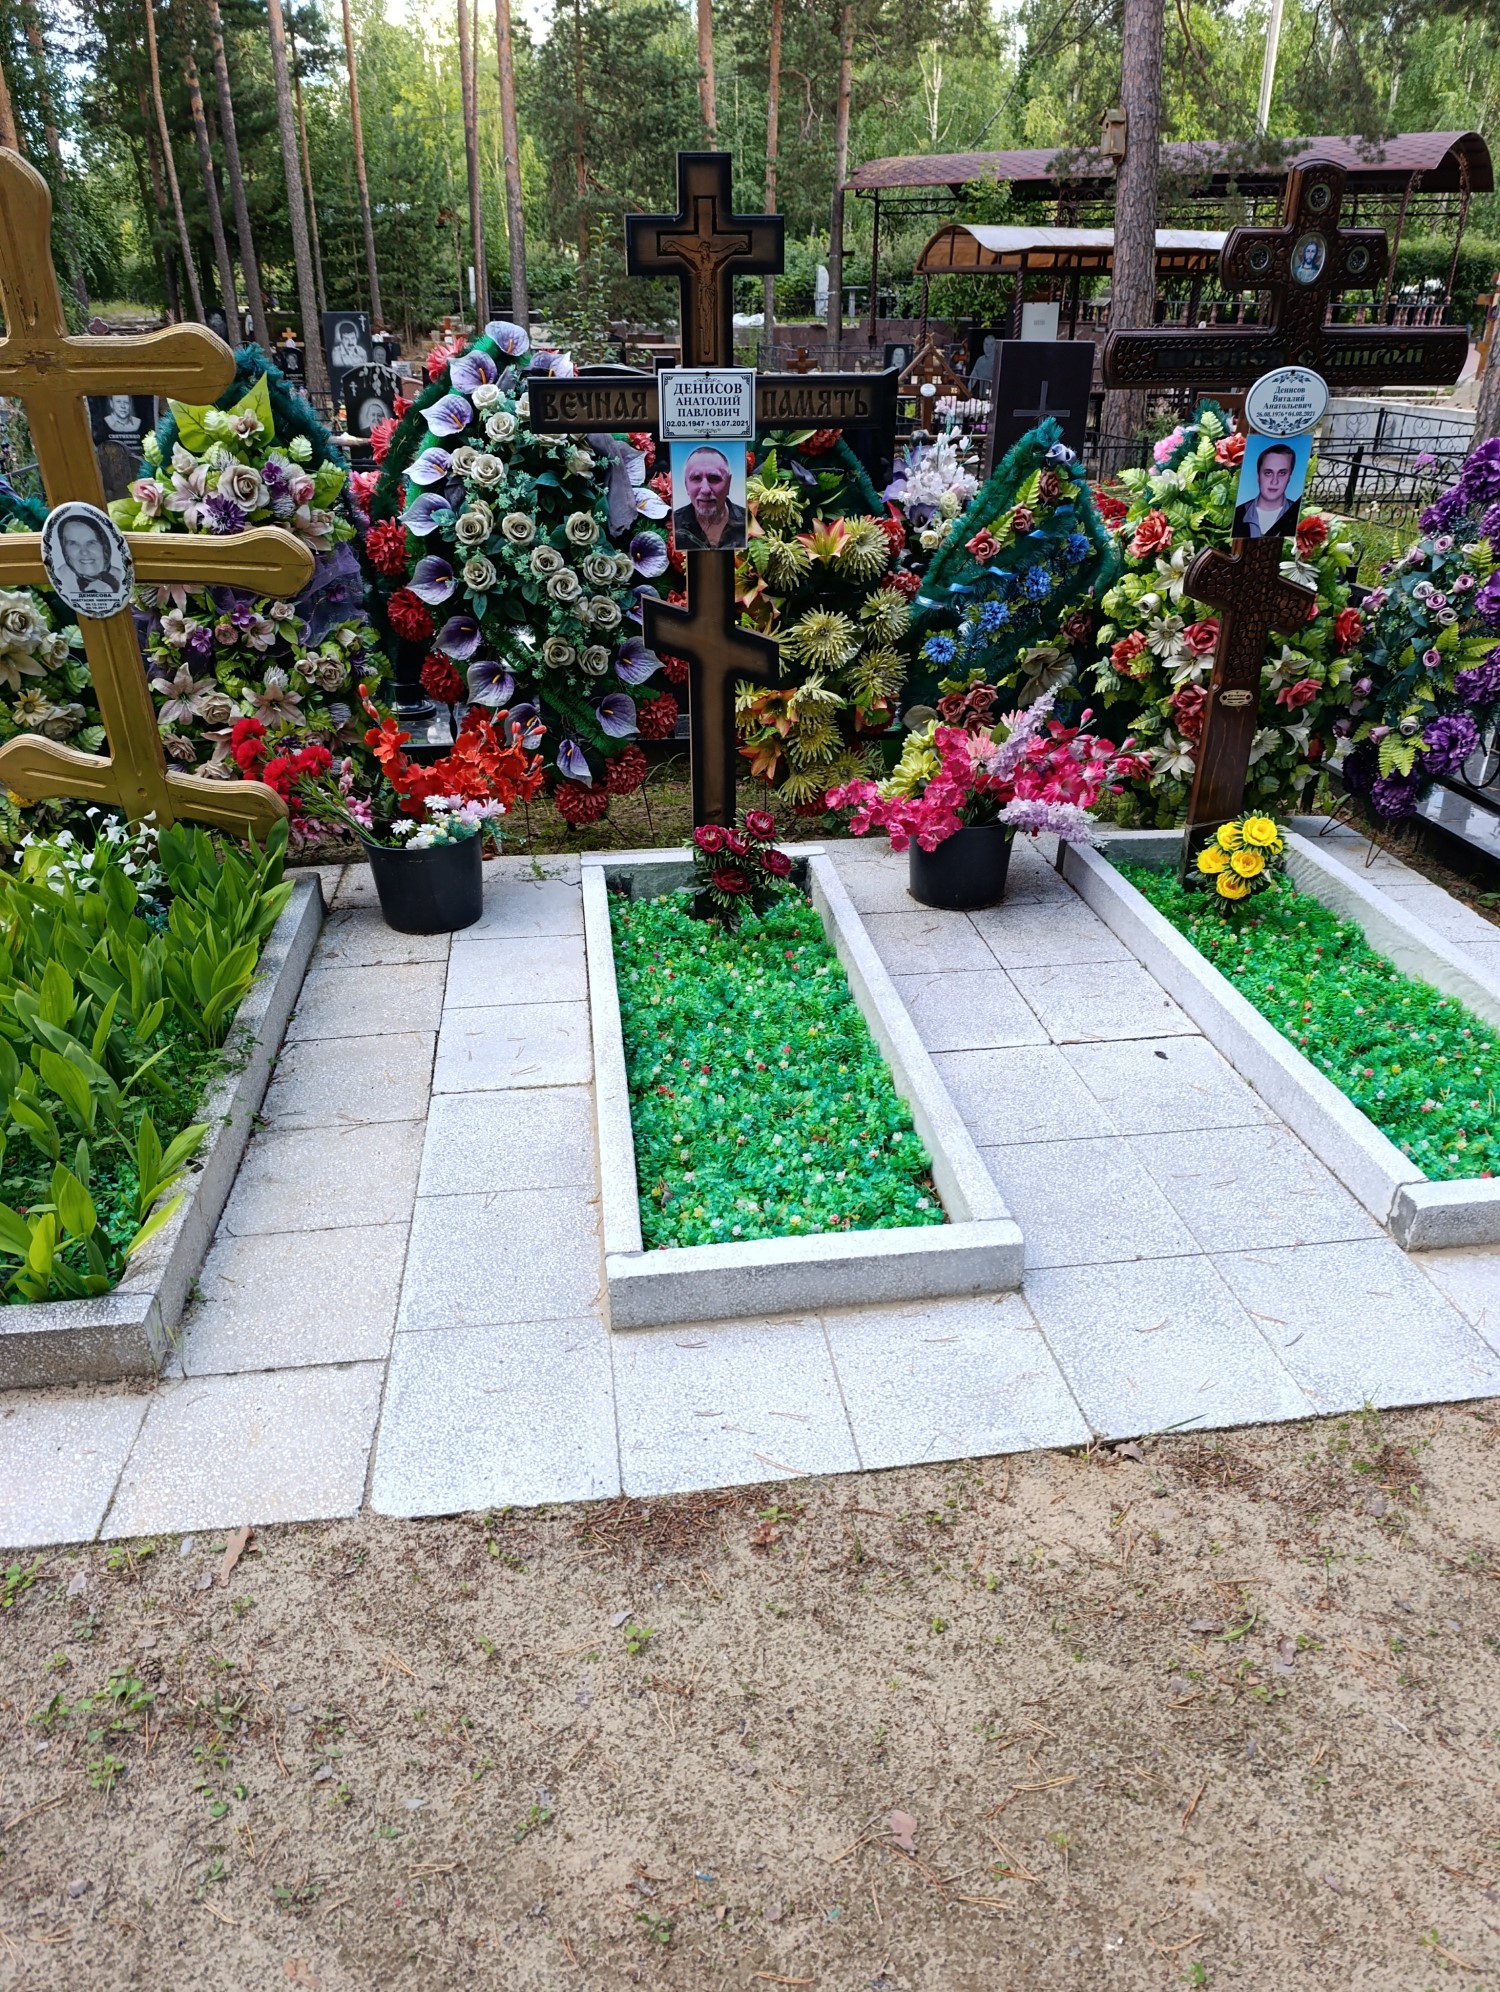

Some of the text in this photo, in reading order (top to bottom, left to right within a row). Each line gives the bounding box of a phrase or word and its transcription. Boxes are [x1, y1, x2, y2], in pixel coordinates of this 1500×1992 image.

[673, 383, 742, 396] ДЕНИСОВ
[1274, 386, 1305, 394] Денисов
[675, 394, 741, 406] АНАТОЛИЙ
[1272, 394, 1305, 402] Виталий
[543, 388, 869, 424] ВЕЧНАЯ ПАМЯТЬ
[1263, 402, 1312, 410] Анатольевич
[677, 408, 740, 417] ПАВЛОВИЧ
